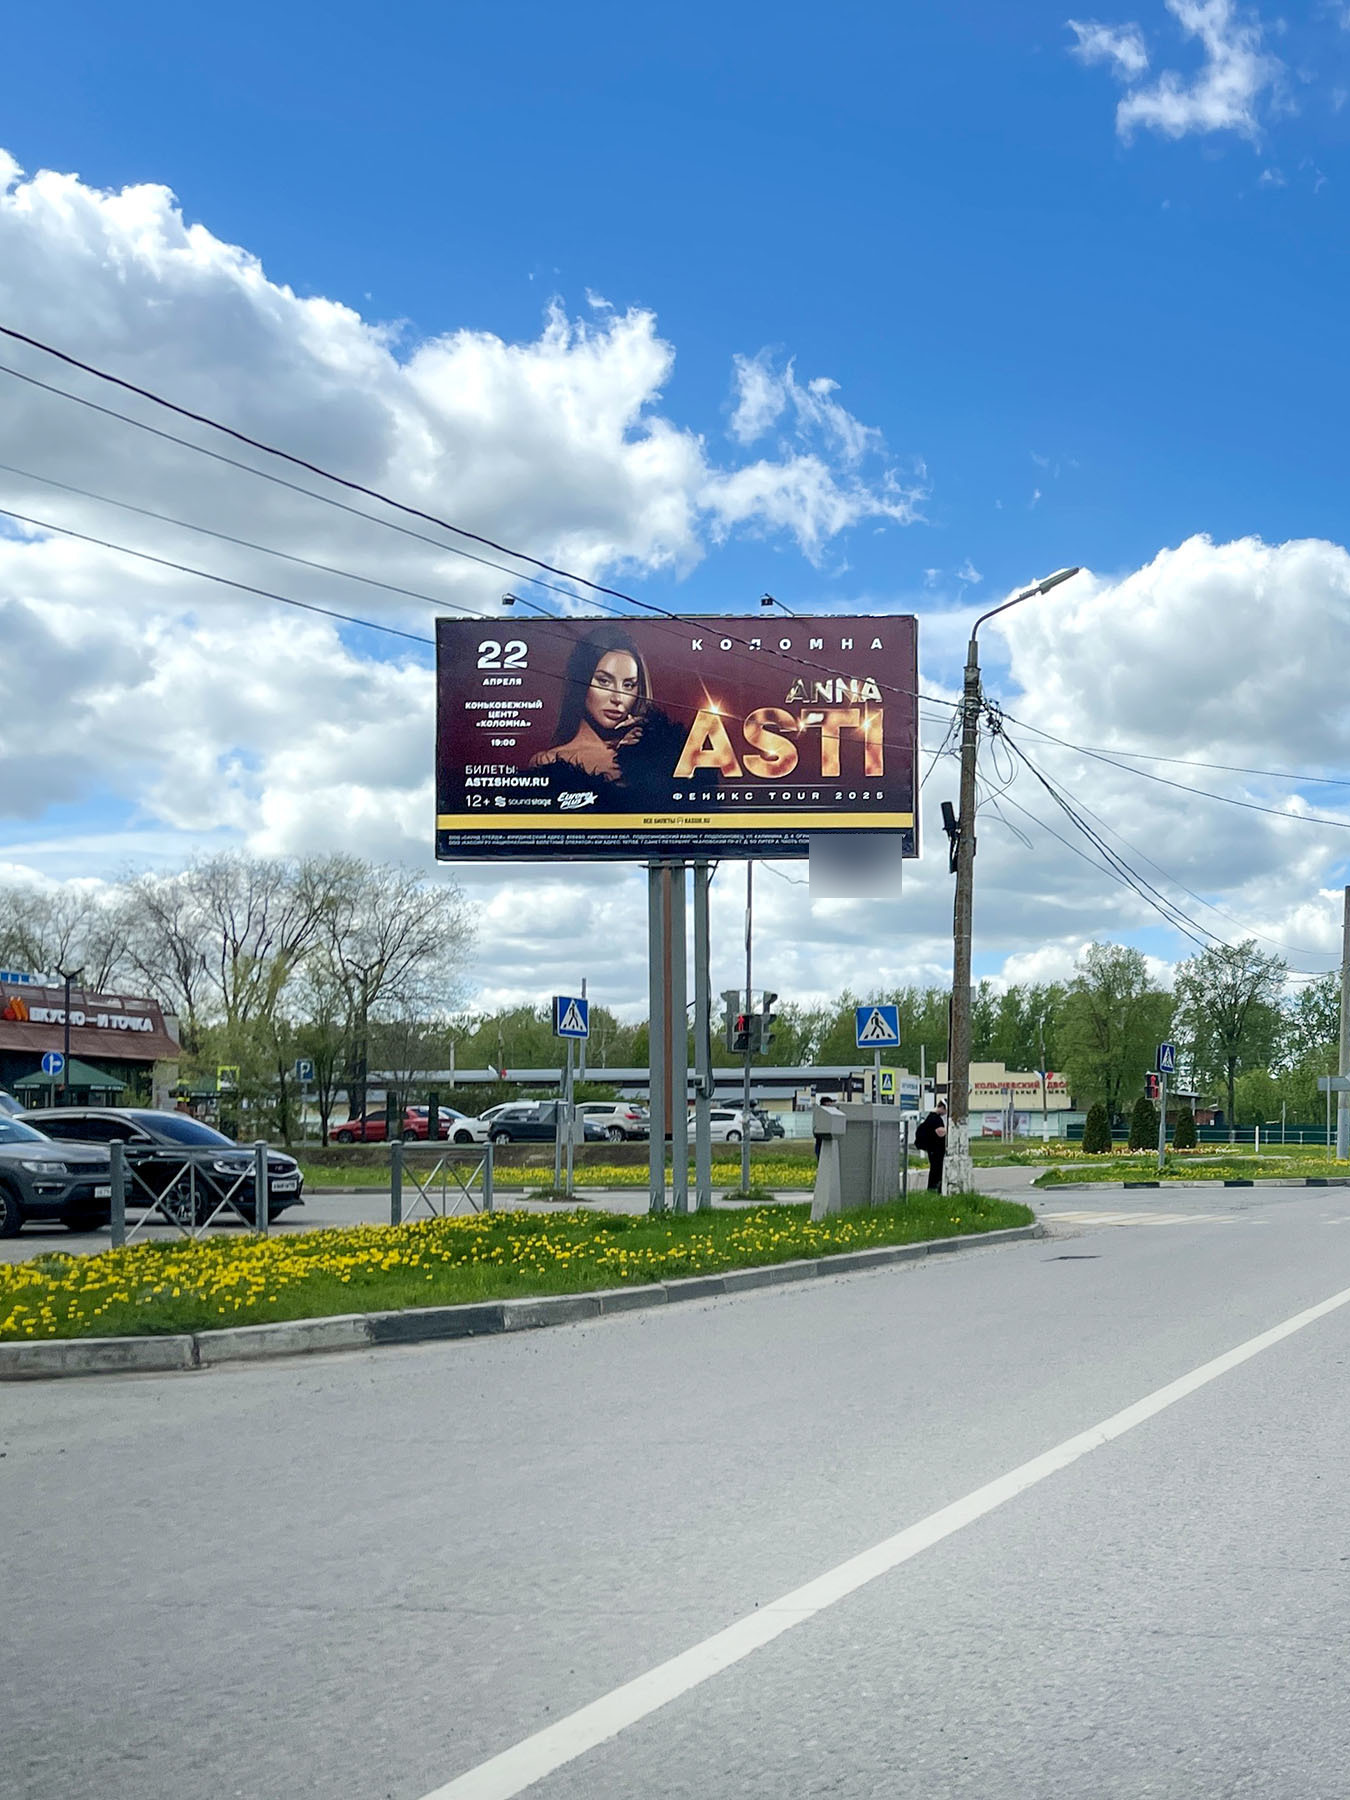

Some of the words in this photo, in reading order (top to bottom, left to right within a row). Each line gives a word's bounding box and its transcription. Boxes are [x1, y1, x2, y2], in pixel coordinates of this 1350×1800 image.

[691, 638, 884, 651] КОЛОМНА
[477, 640, 529, 669] 22
[482, 678, 523, 686] АПРЕЛЯ
[784, 676, 884, 704] ANNA
[464, 700, 544, 710] КОНЬКОБЕЖНЫЙ
[487, 711, 520, 720] ЦЕНТР
[475, 719, 532, 728] «КОЛОМНА»
[490, 738, 517, 747] 19:00
[672, 705, 884, 779] ASTI
[464, 764, 519, 775] БИЛЕТЫ:
[464, 777, 550, 788] ASTISHOW.RU
[465, 794, 491, 807] 12+
[672, 792, 754, 801] ФЕНИКС
[768, 792, 822, 801] TOUR
[834, 791, 885, 801] 2025
[110, 1014, 153, 1032] ТОЧКА
[1046, 1081, 1068, 1089] ДВО
